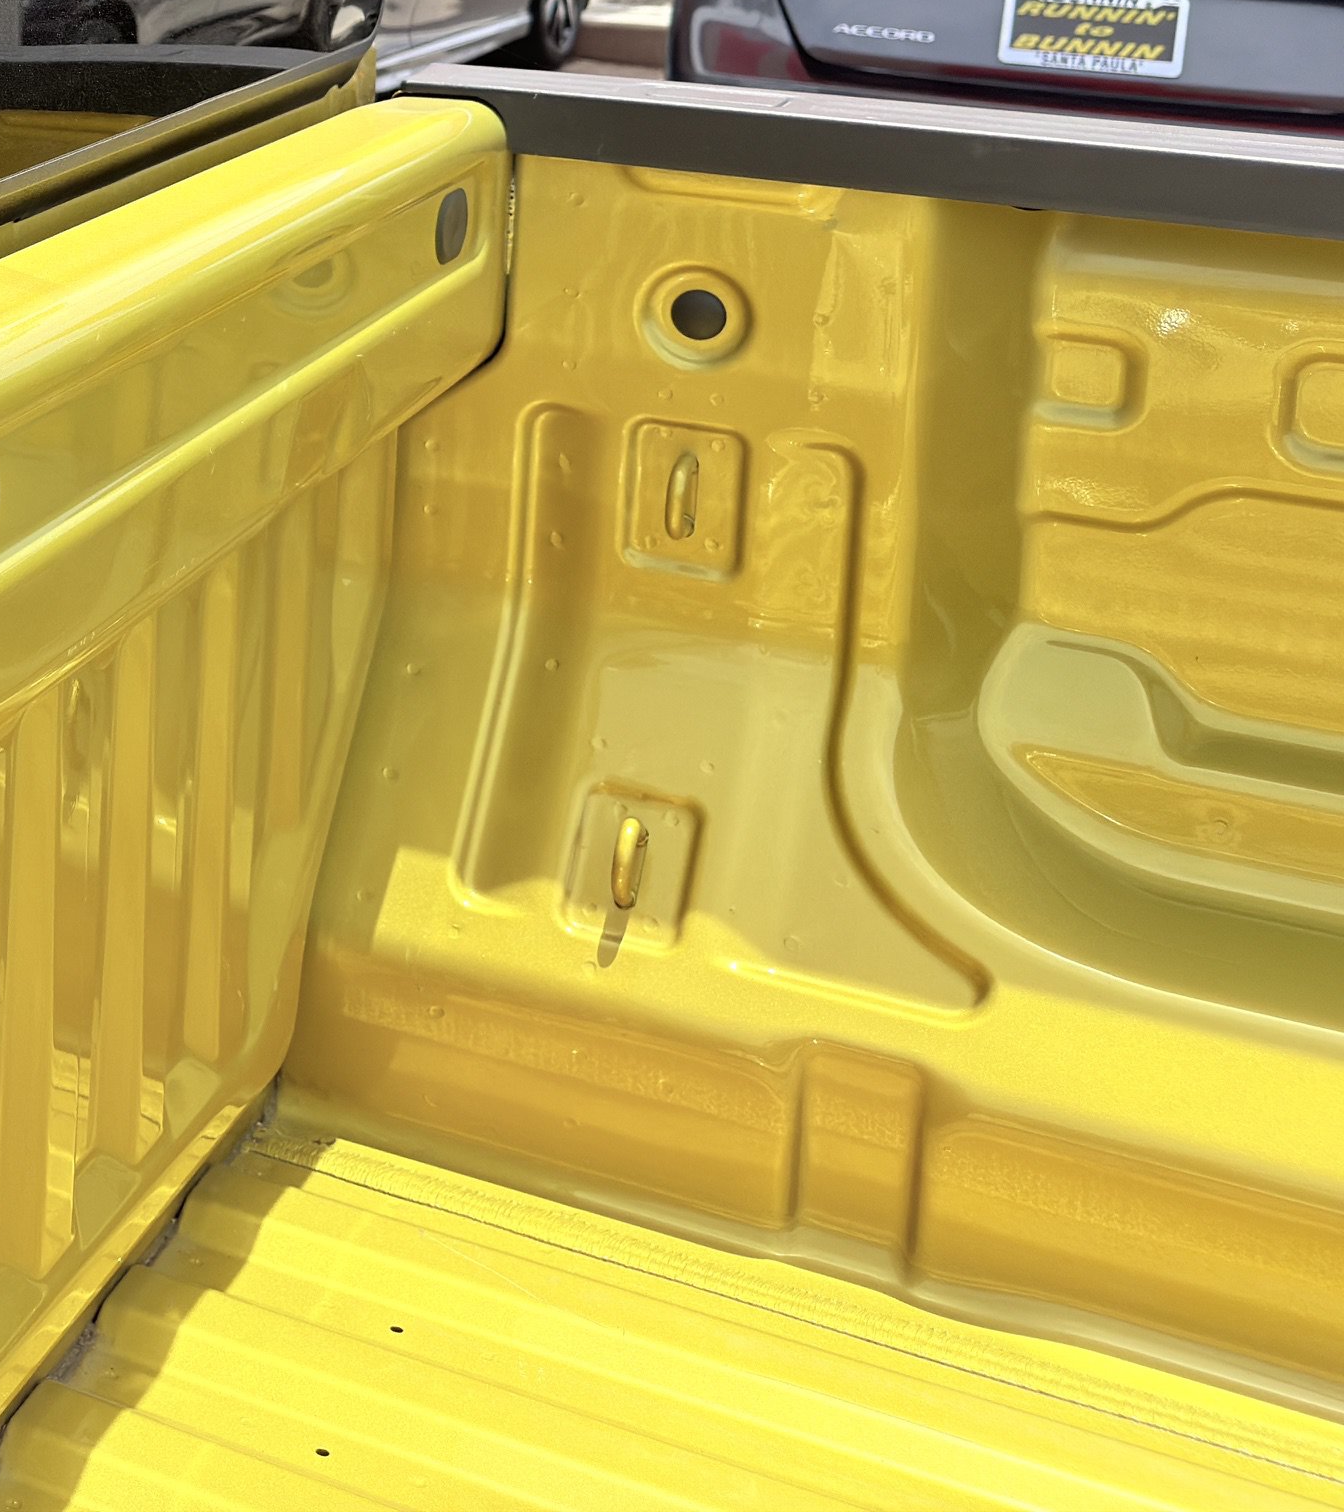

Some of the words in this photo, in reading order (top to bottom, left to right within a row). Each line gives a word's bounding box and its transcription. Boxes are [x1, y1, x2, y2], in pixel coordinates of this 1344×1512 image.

[832, 23, 935, 43] ACCORD
[1074, 22, 1115, 38] to
[1012, 33, 1166, 60] BUNNIN
